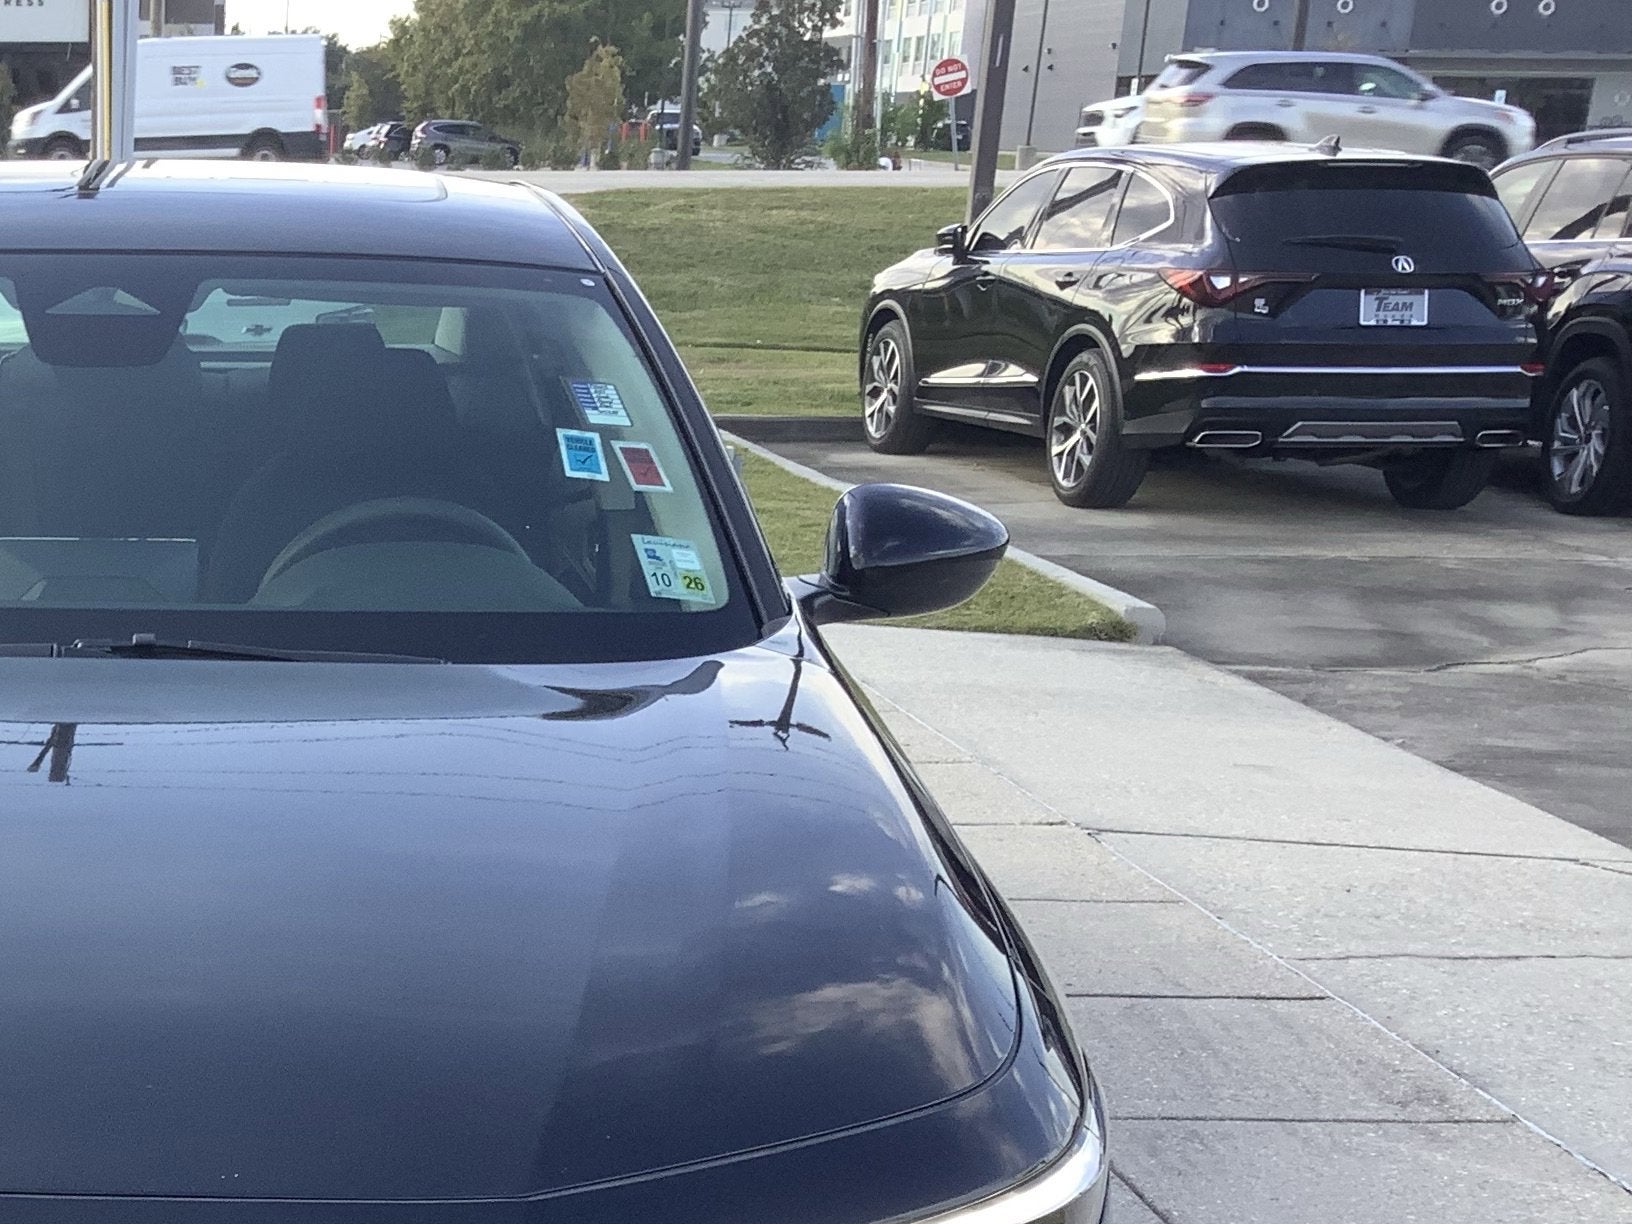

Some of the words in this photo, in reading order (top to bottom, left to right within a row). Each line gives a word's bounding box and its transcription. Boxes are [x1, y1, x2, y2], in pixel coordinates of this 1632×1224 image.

[935, 67, 946, 76] DO
[947, 63, 962, 73] NOT
[940, 80, 963, 92] ENTER
[1374, 297, 1414, 312] TEAM
[1497, 298, 1525, 306] MDX
[651, 571, 672, 588] 10
[683, 575, 705, 591] 26
